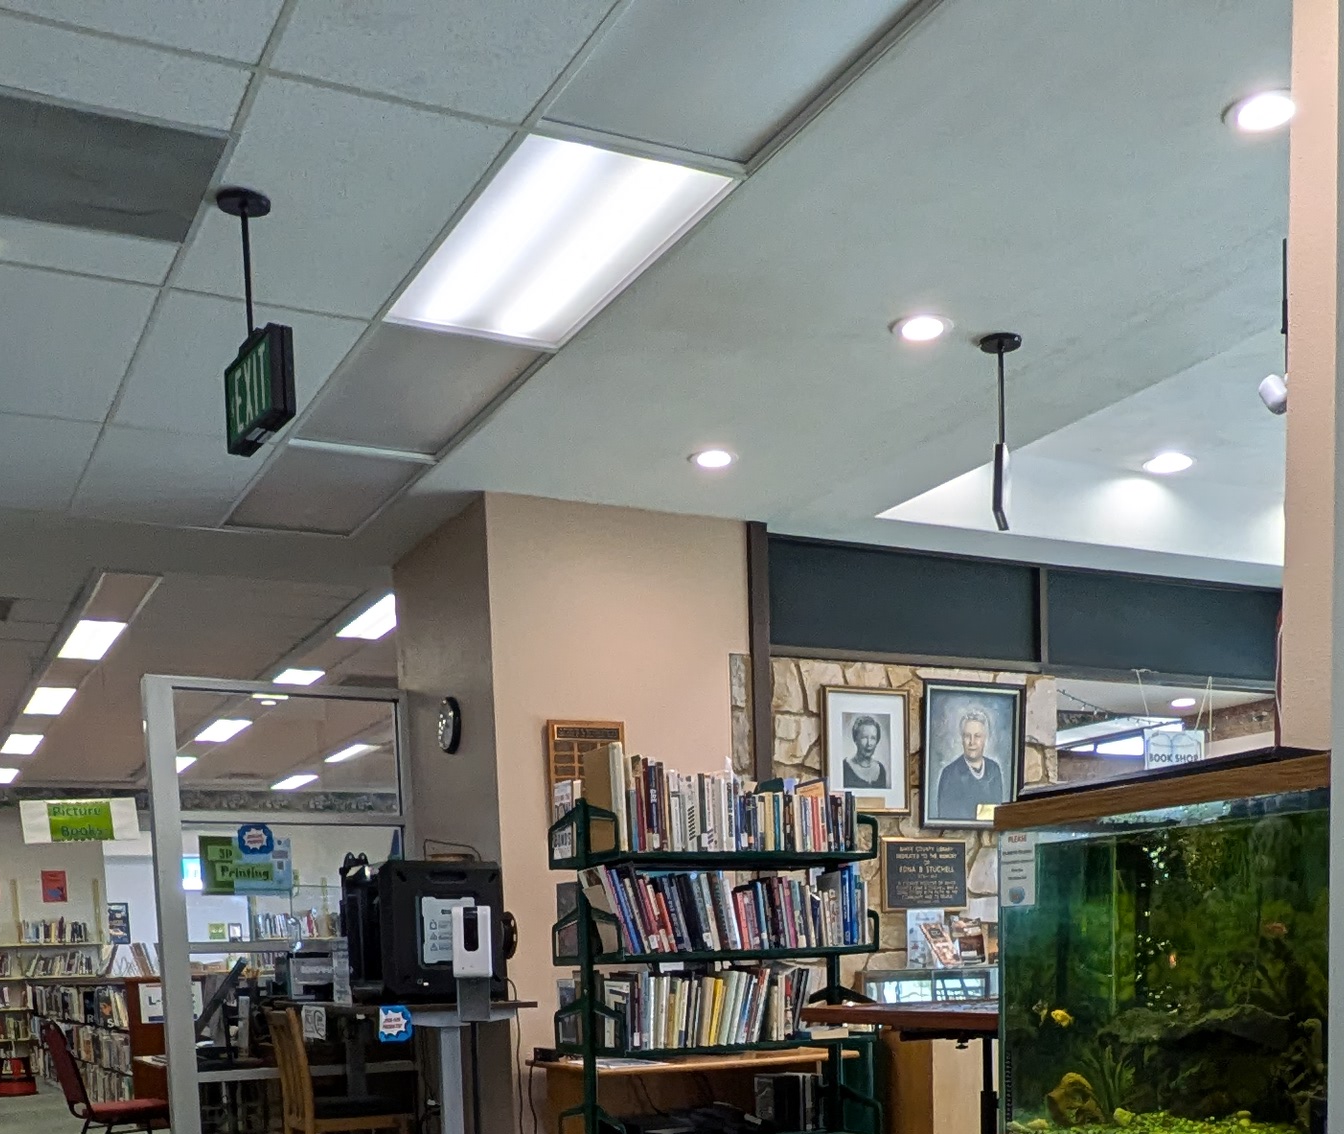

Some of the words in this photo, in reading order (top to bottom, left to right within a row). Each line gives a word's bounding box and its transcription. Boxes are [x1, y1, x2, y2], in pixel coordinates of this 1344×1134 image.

[233, 341, 267, 434] EXIT
[1149, 753, 1173, 763] BOOK
[1175, 753, 1198, 763] SHOP
[52, 806, 101, 817] Picture
[60, 824, 103, 838] Books
[220, 864, 270, 880] Printing
